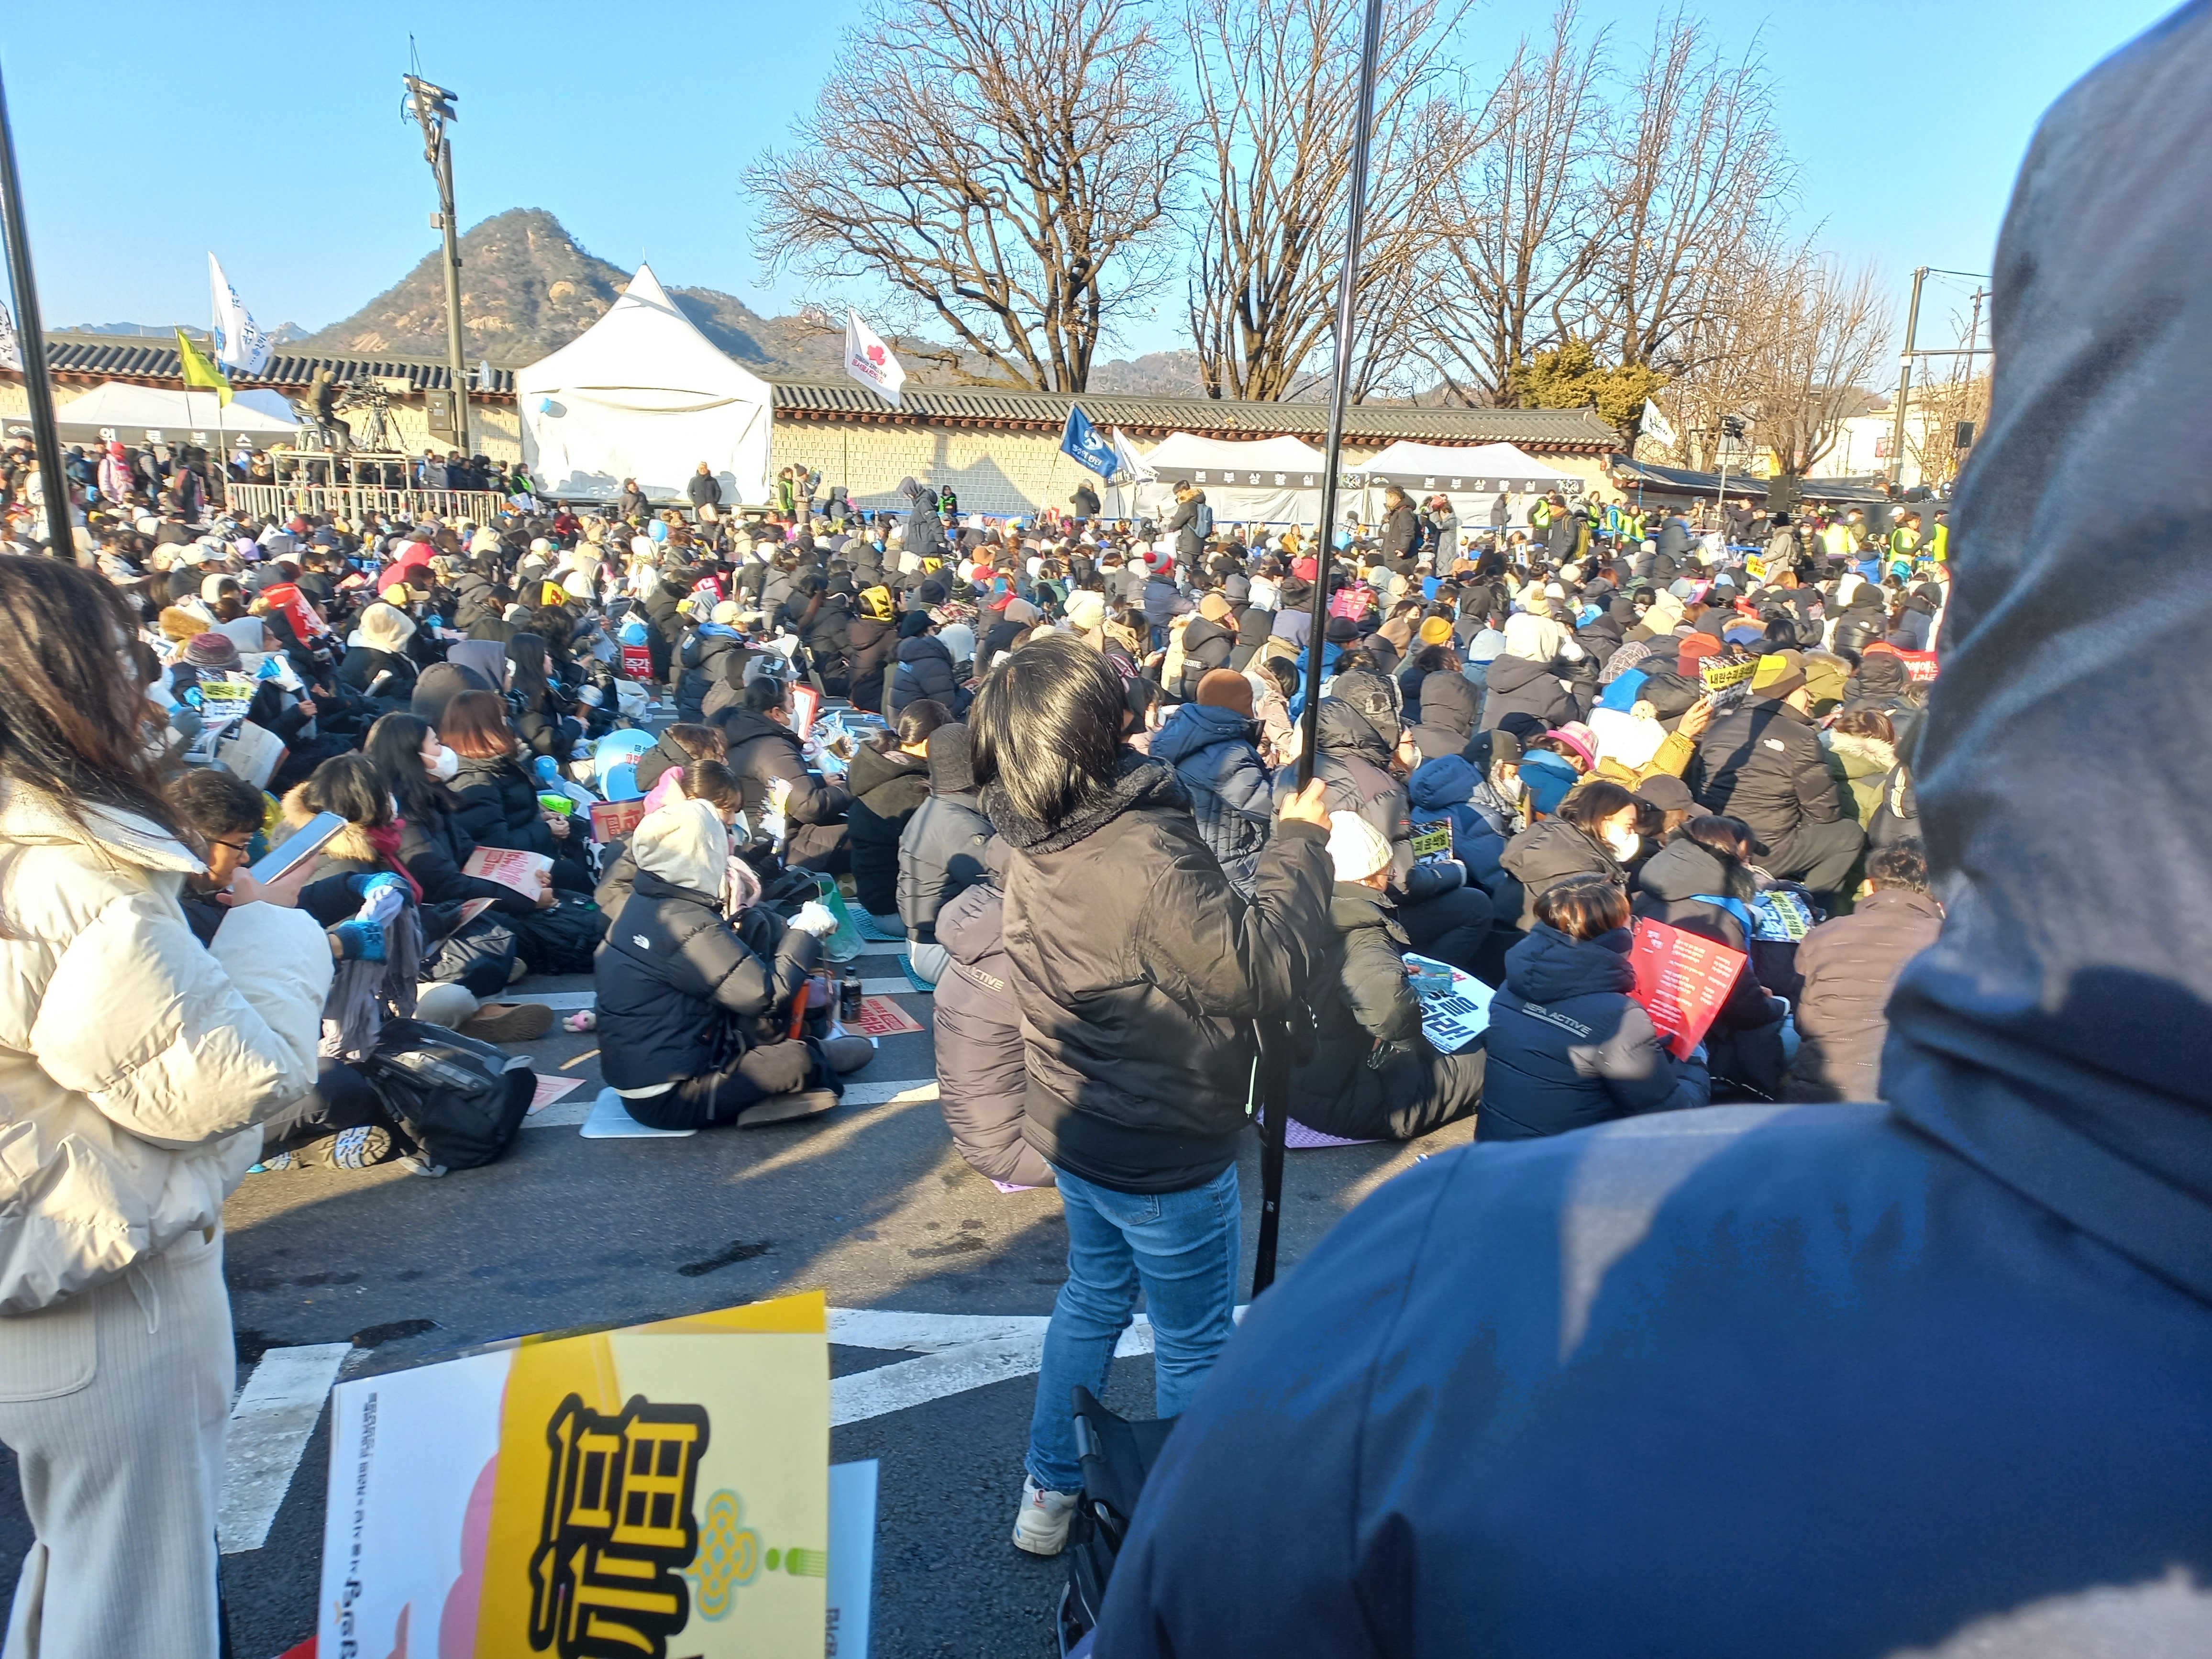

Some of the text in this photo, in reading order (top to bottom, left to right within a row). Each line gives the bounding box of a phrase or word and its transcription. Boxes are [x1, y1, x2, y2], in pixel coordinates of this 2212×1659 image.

[1194, 470, 1314, 486] 본부상황실
[1424, 477, 1536, 492] 본부상황실
[625, 658, 650, 673] 즉각
[1710, 669, 1738, 685] 내란수괴
[1548, 1012, 1593, 1034] ACTIVE
[529, 1391, 711, 1659] 福
